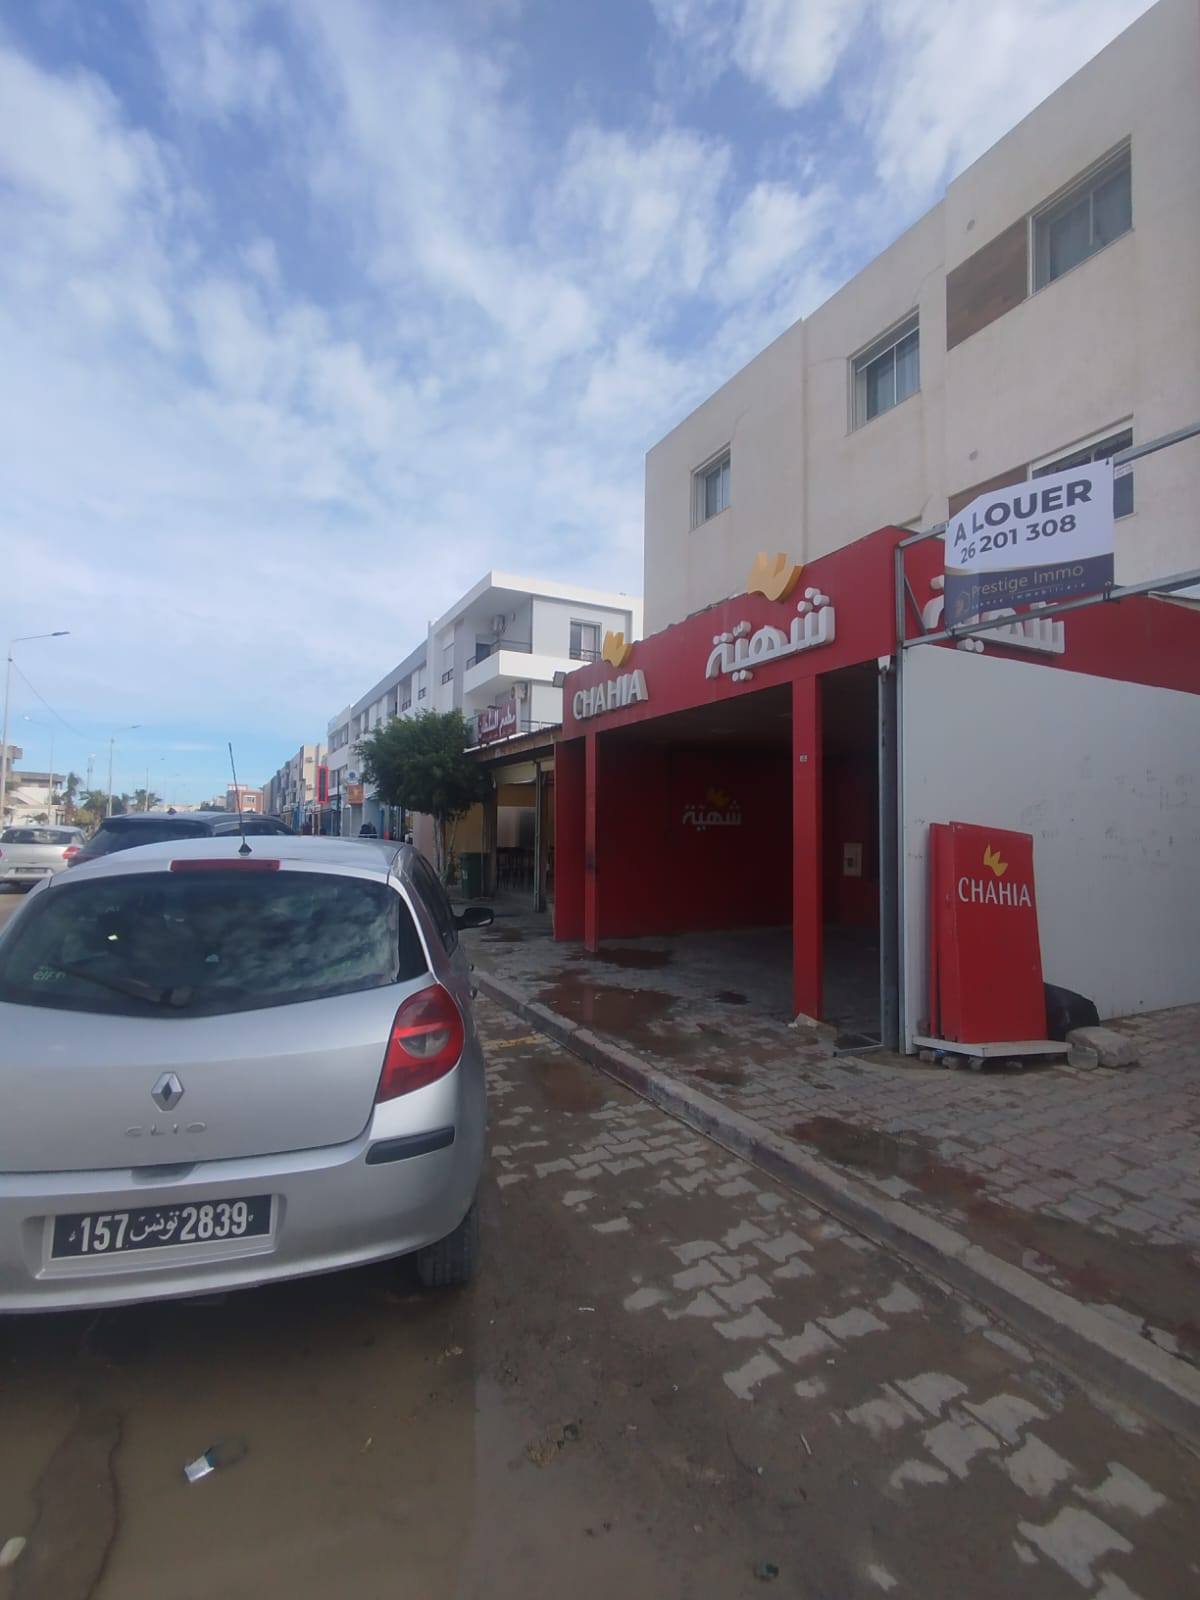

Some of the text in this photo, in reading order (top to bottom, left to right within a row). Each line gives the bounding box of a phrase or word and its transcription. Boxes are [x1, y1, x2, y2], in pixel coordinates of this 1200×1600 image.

[953, 479, 1092, 547] A LOUER
[961, 514, 1076, 564] 26 201 308
[1033, 564, 1084, 584] Immo
[573, 669, 648, 720] CHAHIA
[958, 876, 1032, 907] CHAHIA
[124, 1121, 207, 1138] CLIO
[81, 1201, 248, 1251] 157 تونس 2839
